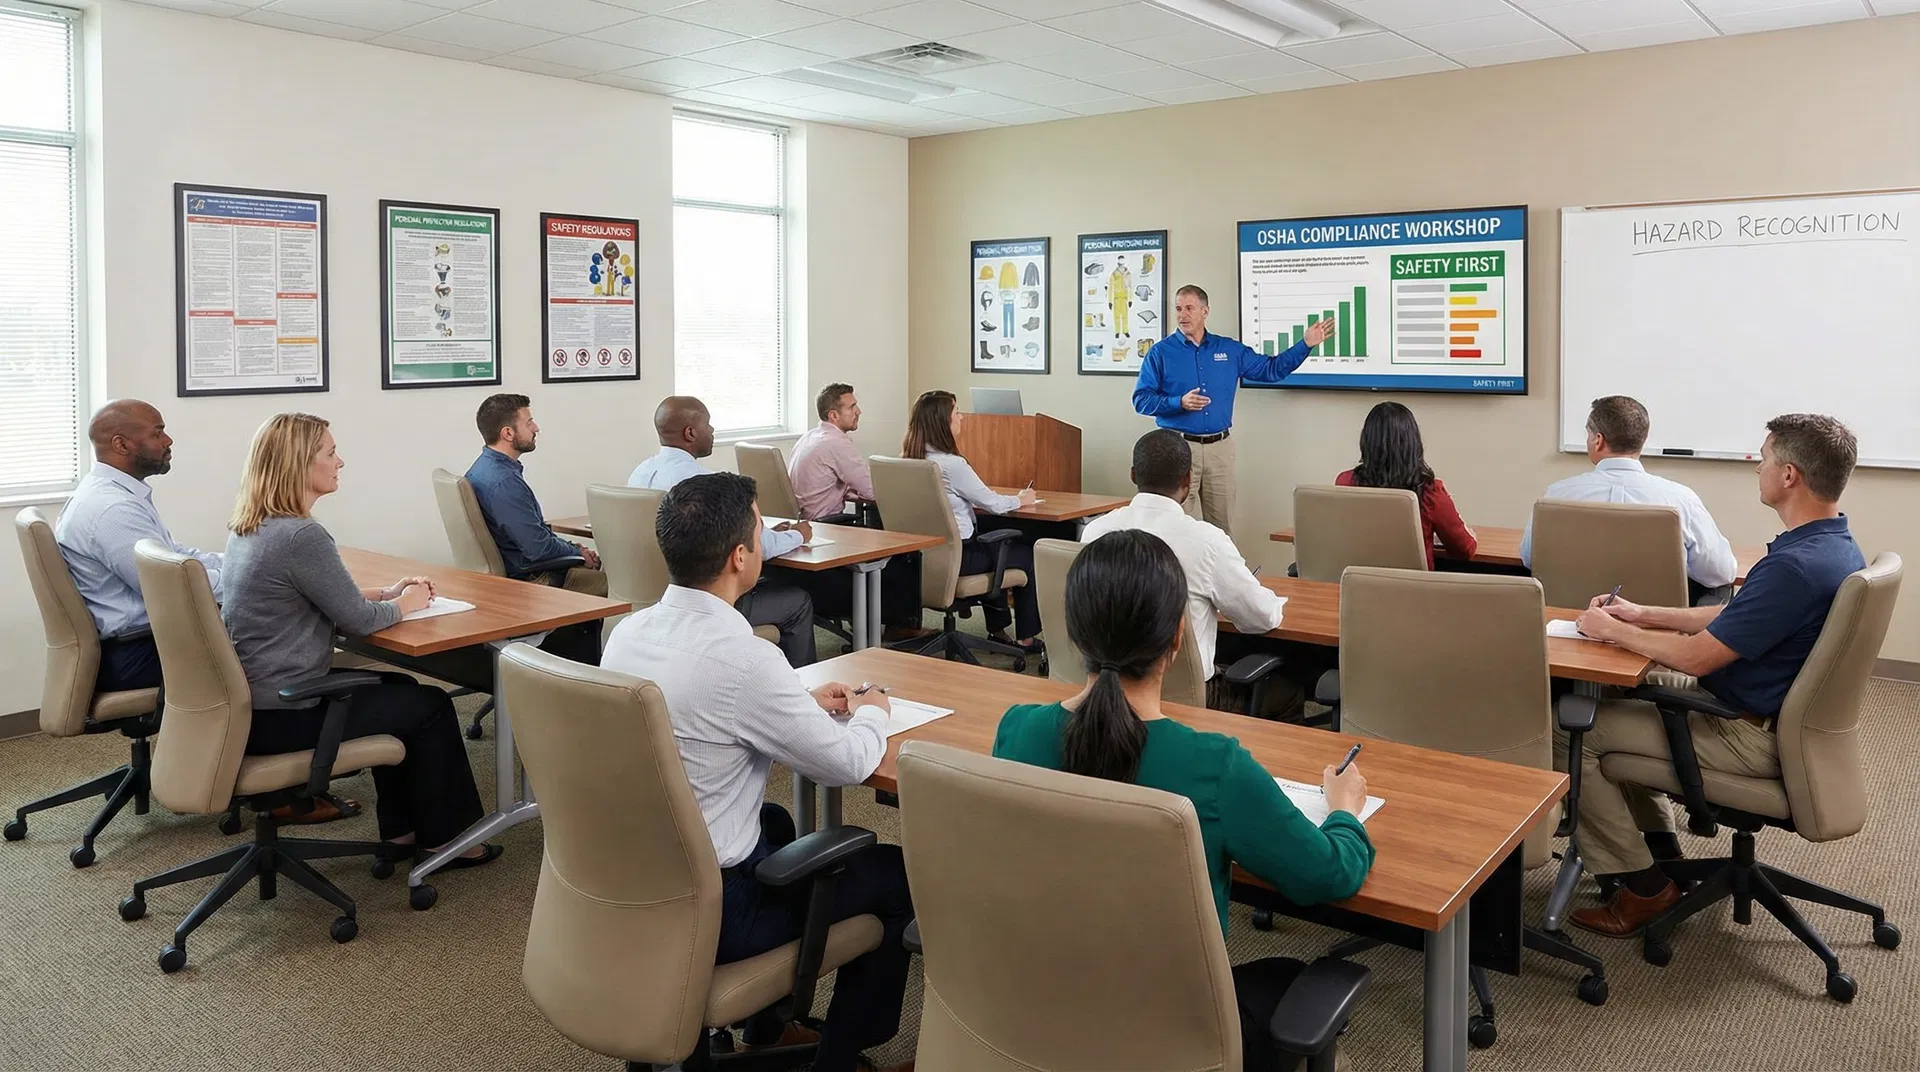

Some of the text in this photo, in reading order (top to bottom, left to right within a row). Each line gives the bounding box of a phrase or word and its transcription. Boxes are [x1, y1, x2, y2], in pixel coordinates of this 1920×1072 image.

[551, 222, 581, 233] SAFETY
[1257, 217, 1501, 246] OSHA COMPLIANCE WORKSHOP
[1633, 212, 1900, 245] HAZARD RECOGNITION
[1395, 256, 1500, 275] SAFETY FIRST
